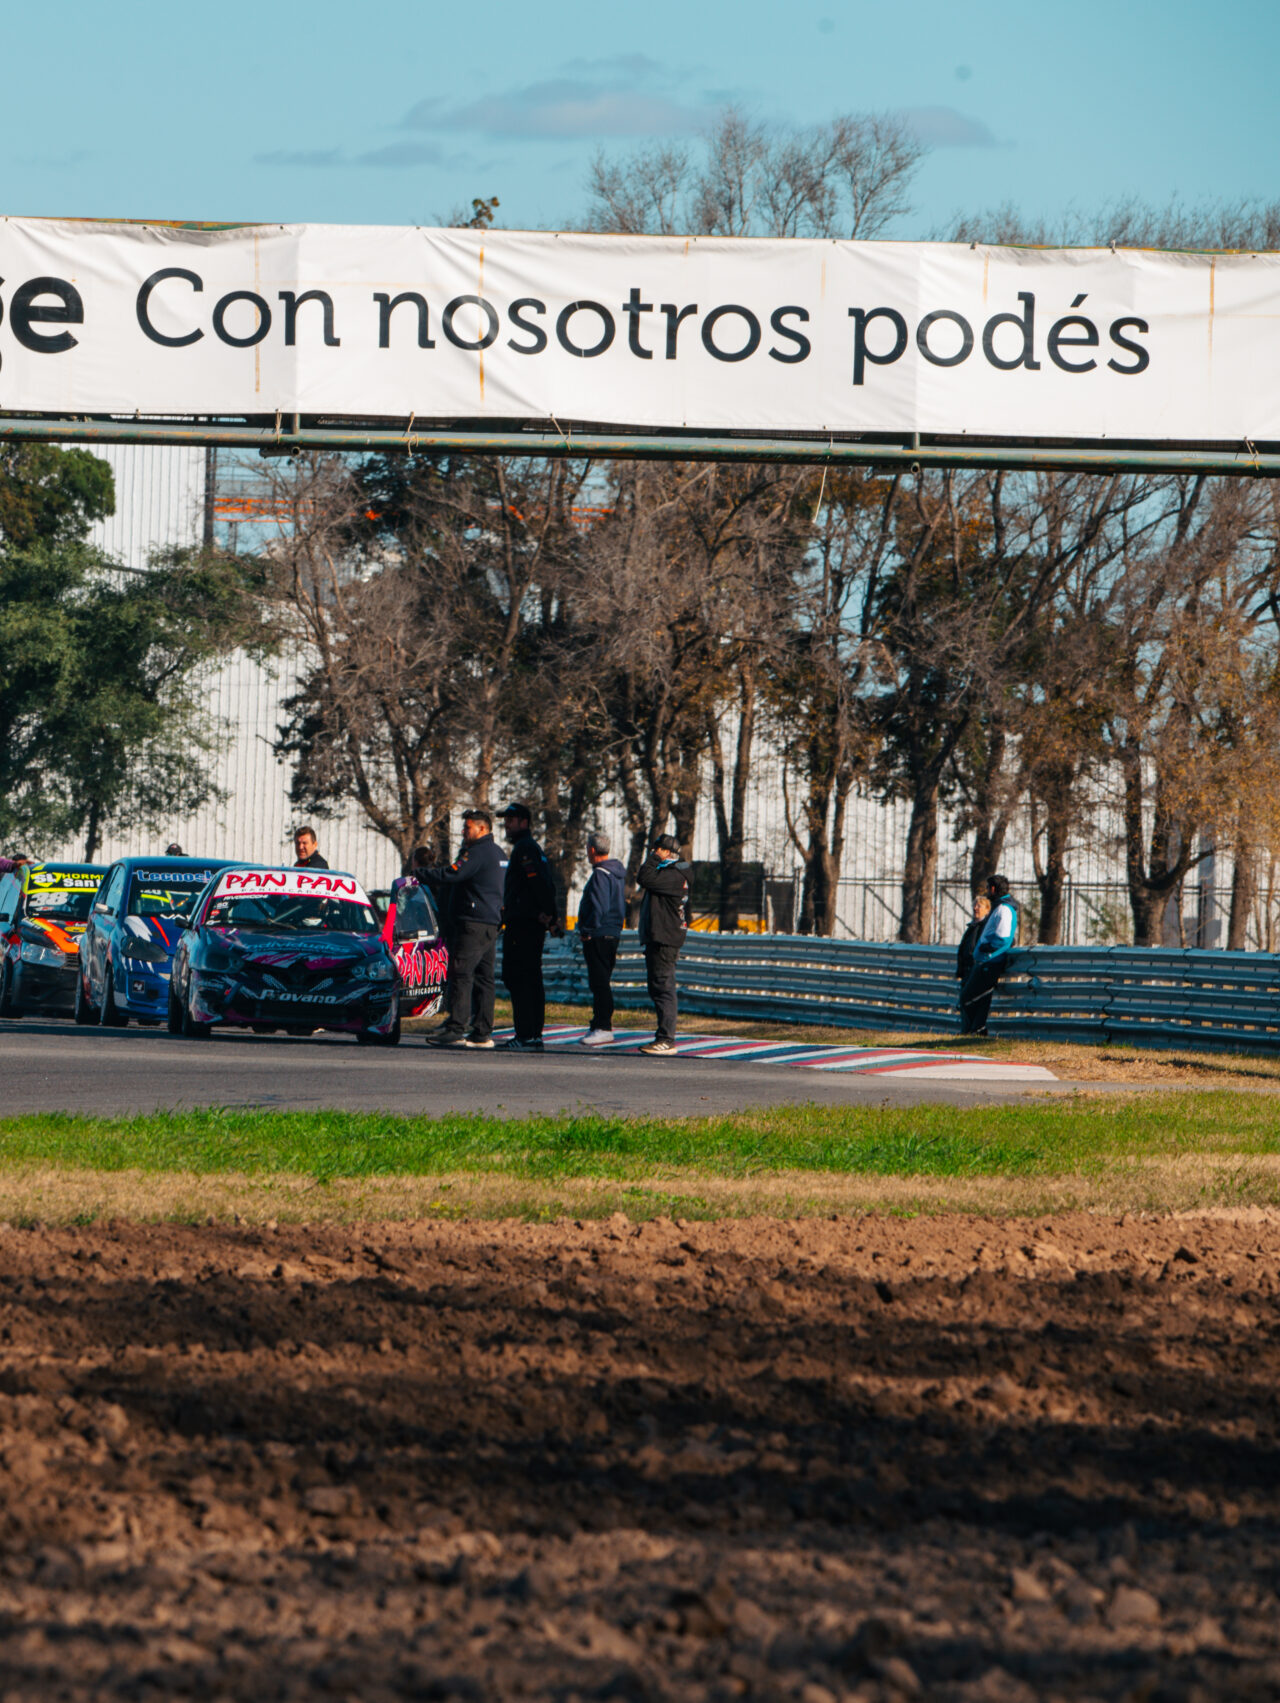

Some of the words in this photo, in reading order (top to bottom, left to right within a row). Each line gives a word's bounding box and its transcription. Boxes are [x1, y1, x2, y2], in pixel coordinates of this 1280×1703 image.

[136, 267, 341, 349] Con
[373, 288, 811, 364] nosotros
[848, 291, 1150, 386] podés
[226, 873, 287, 890] PAN
[297, 875, 357, 894] PAN
[29, 891, 69, 908] 38
[424, 946, 449, 987] PAN
